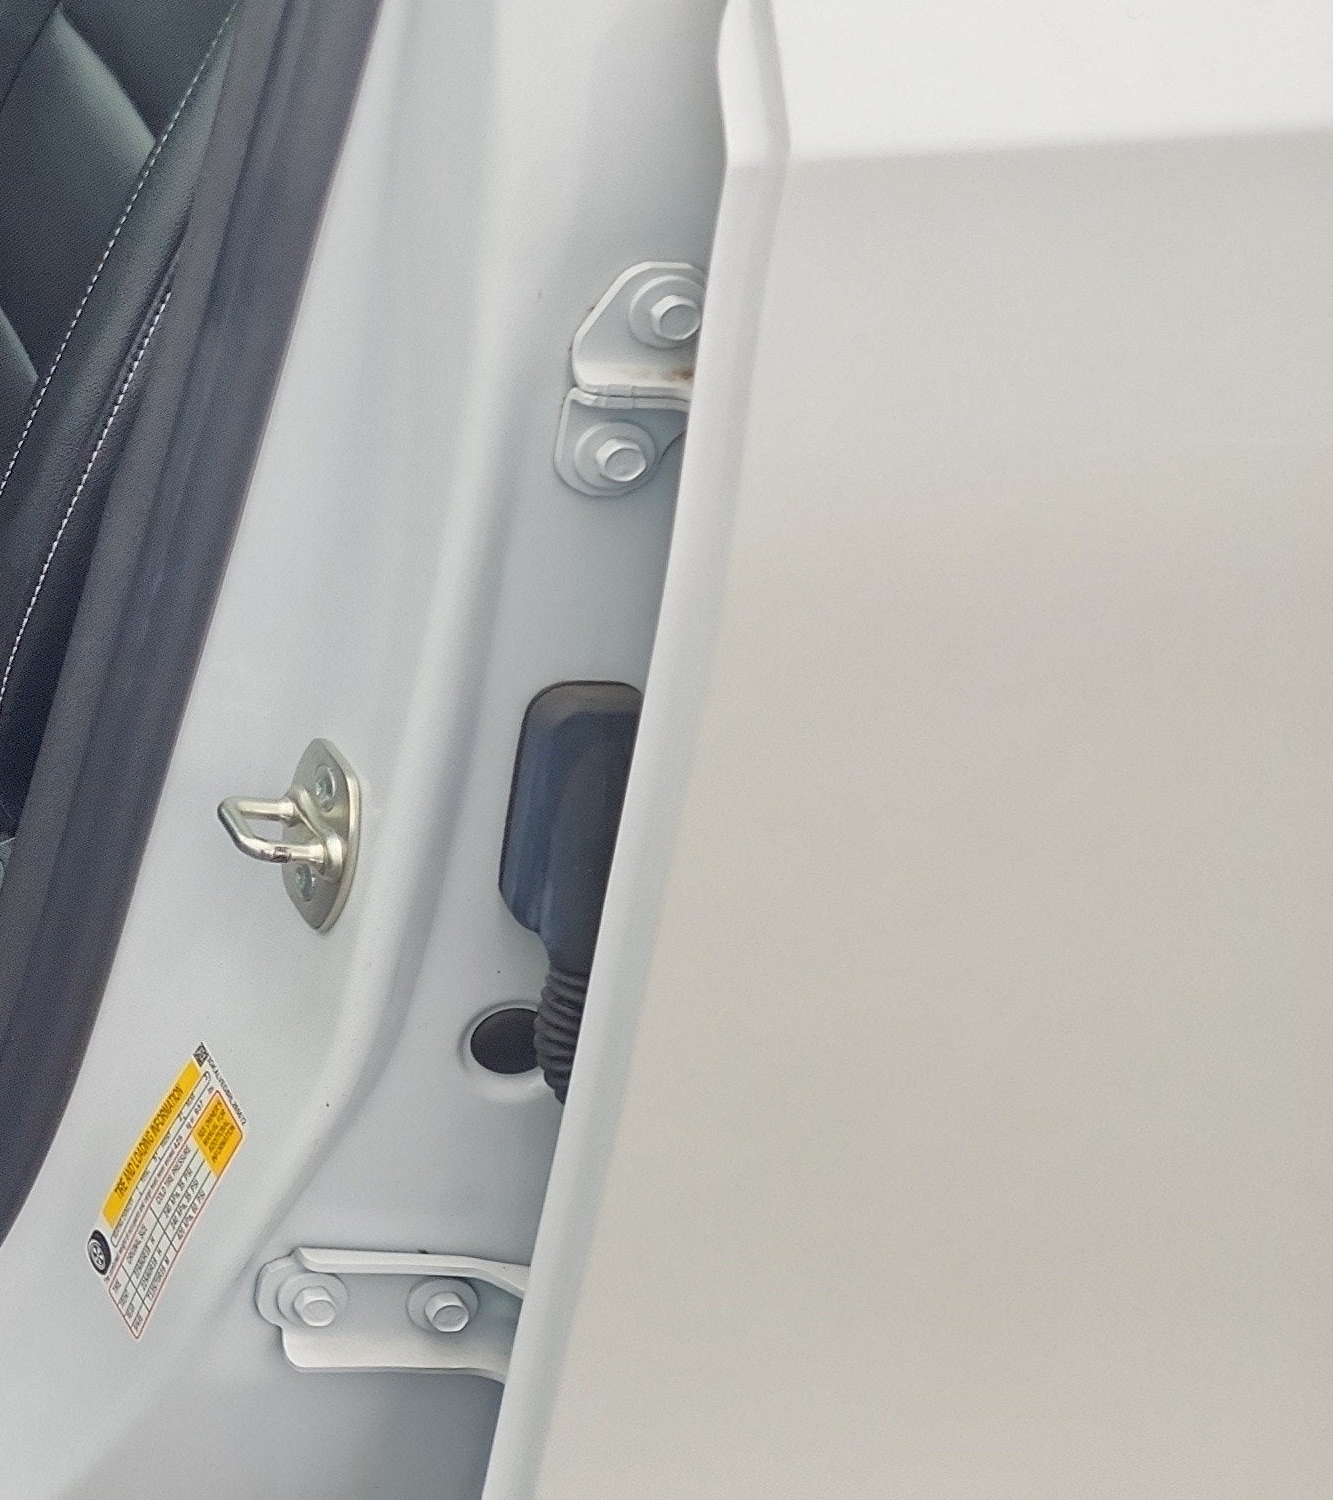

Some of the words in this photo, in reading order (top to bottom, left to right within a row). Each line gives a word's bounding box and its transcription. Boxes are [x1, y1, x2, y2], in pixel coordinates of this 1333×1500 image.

[114, 1179, 128, 1199] TIRE
[123, 1163, 136, 1182] AND
[133, 1129, 154, 1167] LOADING
[149, 1083, 184, 1133] INFORMATION
